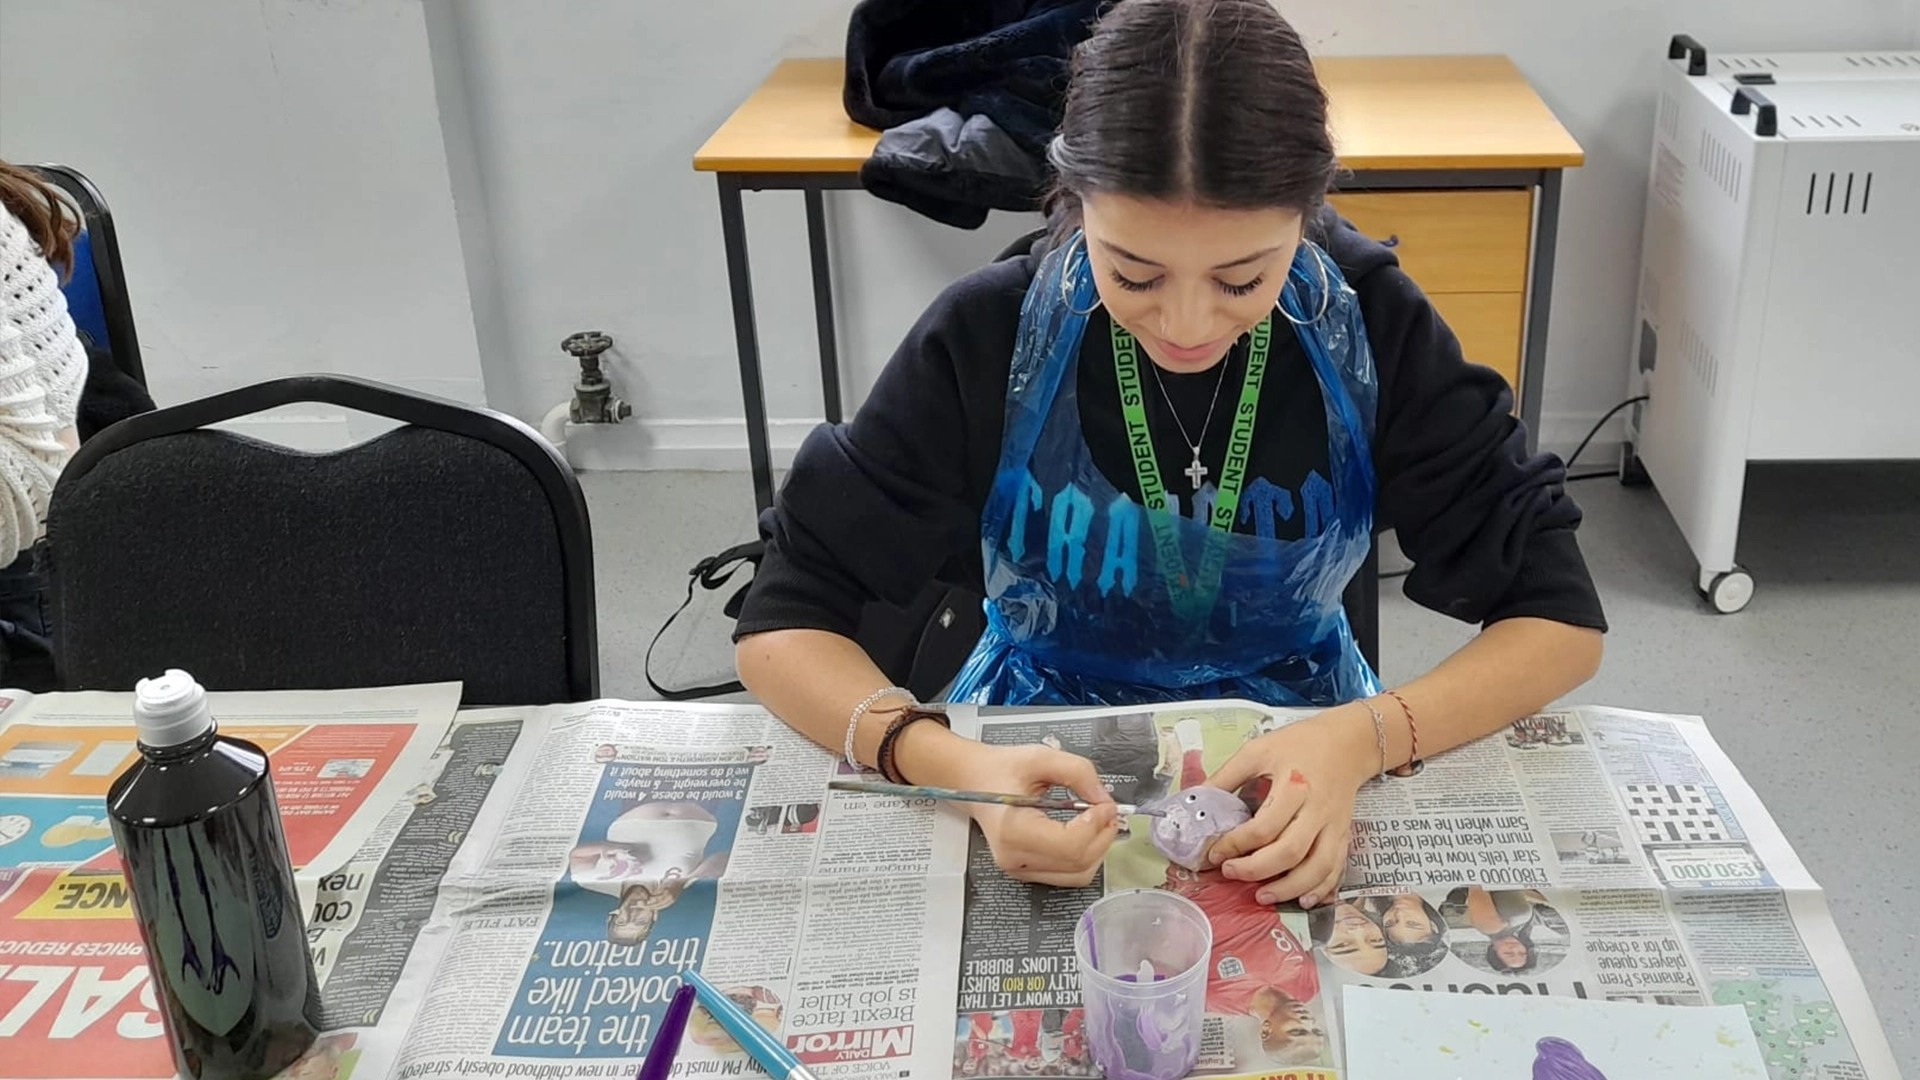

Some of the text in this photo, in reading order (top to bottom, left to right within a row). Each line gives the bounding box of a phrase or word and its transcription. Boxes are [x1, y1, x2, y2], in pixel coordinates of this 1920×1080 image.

[1246, 315, 1270, 389] UDENT
[1113, 321, 1141, 406] STUDEN
[1222, 402, 1254, 496] STUDENT
[1128, 421, 1165, 510] STUDENT
[610, 766, 750, 778] we'd do something about it
[615, 778, 652, 789] maybe
[653, 779, 661, 789] &
[733, 779, 747, 789] be
[604, 790, 744, 801] 3 would be obese, 4 would
[914, 798, 937, 807] Go
[873, 799, 911, 810] Kane
[1354, 816, 1529, 836] 5am when he was a child
[1369, 835, 1414, 851] toilets
[1416, 834, 1454, 850] hotel
[1454, 833, 1494, 849] clean
[1496, 831, 1534, 846] mum
[1348, 849, 1540, 870] star tells how he helped his
[818, 863, 930, 875] Hunger shame
[1363, 866, 1548, 886] £180,000 a week England
[1670, 862, 1756, 879] £30,000
[317, 873, 364, 892] nex
[55, 882, 128, 909] NCE.
[503, 917, 539, 928] FAT
[0, 941, 143, 956] PRICES REDUC
[1584, 936, 1680, 955] up for a cheque
[651, 937, 700, 973] the
[1598, 952, 1686, 971] players queue
[964, 958, 1014, 976] BUBBLE
[1018, 956, 1058, 974] LIONS'
[959, 973, 1080, 993] ALTY (OR RIO) BURST
[1596, 972, 1696, 988] Panama's Prem
[0, 965, 164, 1039] SAL
[527, 975, 683, 1015] ooked like
[798, 986, 917, 1011] is job killer
[957, 990, 1084, 1009] LKER WON'T LET THAT
[792, 1005, 915, 1028] Brexit farce
[507, 1014, 650, 1055] the team
[786, 1027, 912, 1058] Mirror
[835, 1049, 870, 1060] DAILY
[454, 1058, 505, 1078] obesity
[508, 1063, 573, 1080] childhood
[577, 1065, 604, 1077] new
[608, 1065, 619, 1078] in
[682, 1061, 719, 1077] must
[721, 1060, 742, 1076] PM
[809, 1061, 891, 1076] VOICE OF TH
